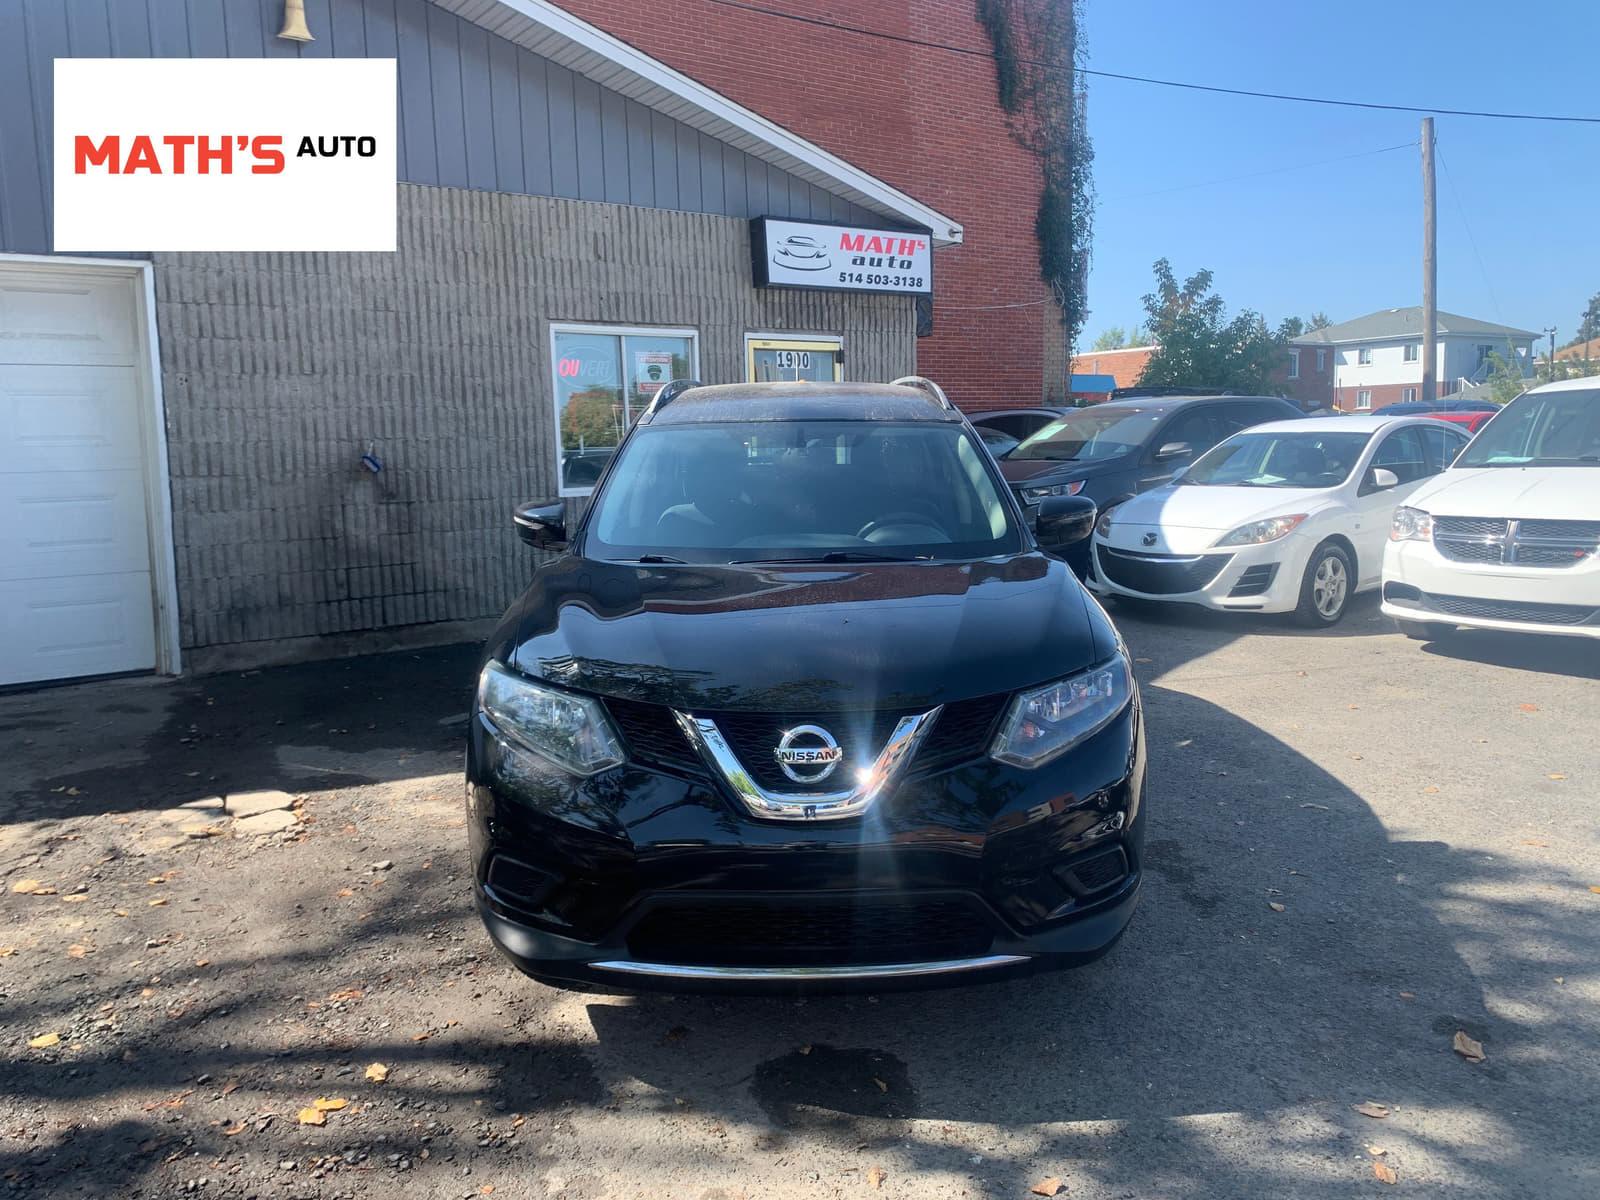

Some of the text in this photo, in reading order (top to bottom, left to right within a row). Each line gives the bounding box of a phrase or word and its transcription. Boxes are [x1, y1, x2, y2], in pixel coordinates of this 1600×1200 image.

[852, 255, 912, 269] auto
[839, 272, 923, 287] 514 503-3138
[781, 751, 835, 761] NISSAN
